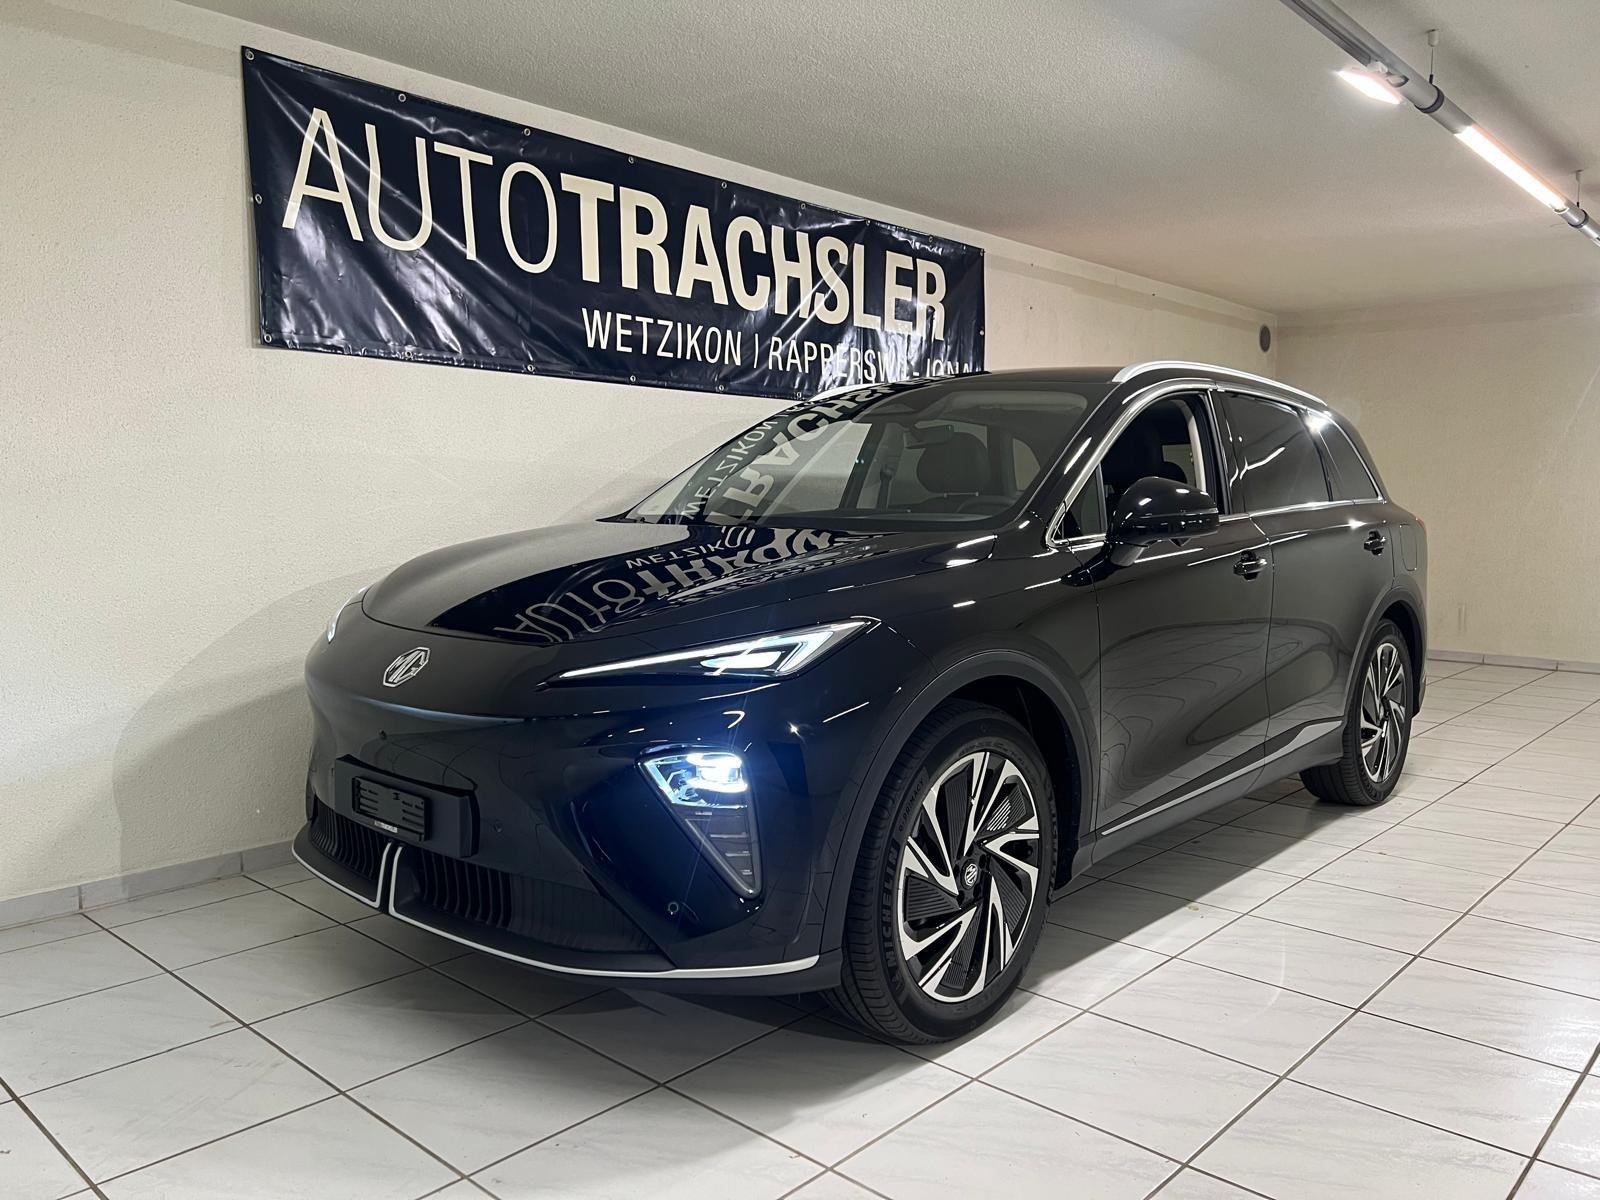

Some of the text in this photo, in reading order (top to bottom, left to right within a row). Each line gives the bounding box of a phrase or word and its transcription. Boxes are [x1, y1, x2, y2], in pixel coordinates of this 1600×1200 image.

[582, 307, 741, 366] WETZIKON
[386, 648, 428, 685] MG
[883, 845, 898, 968] MICHELIN
